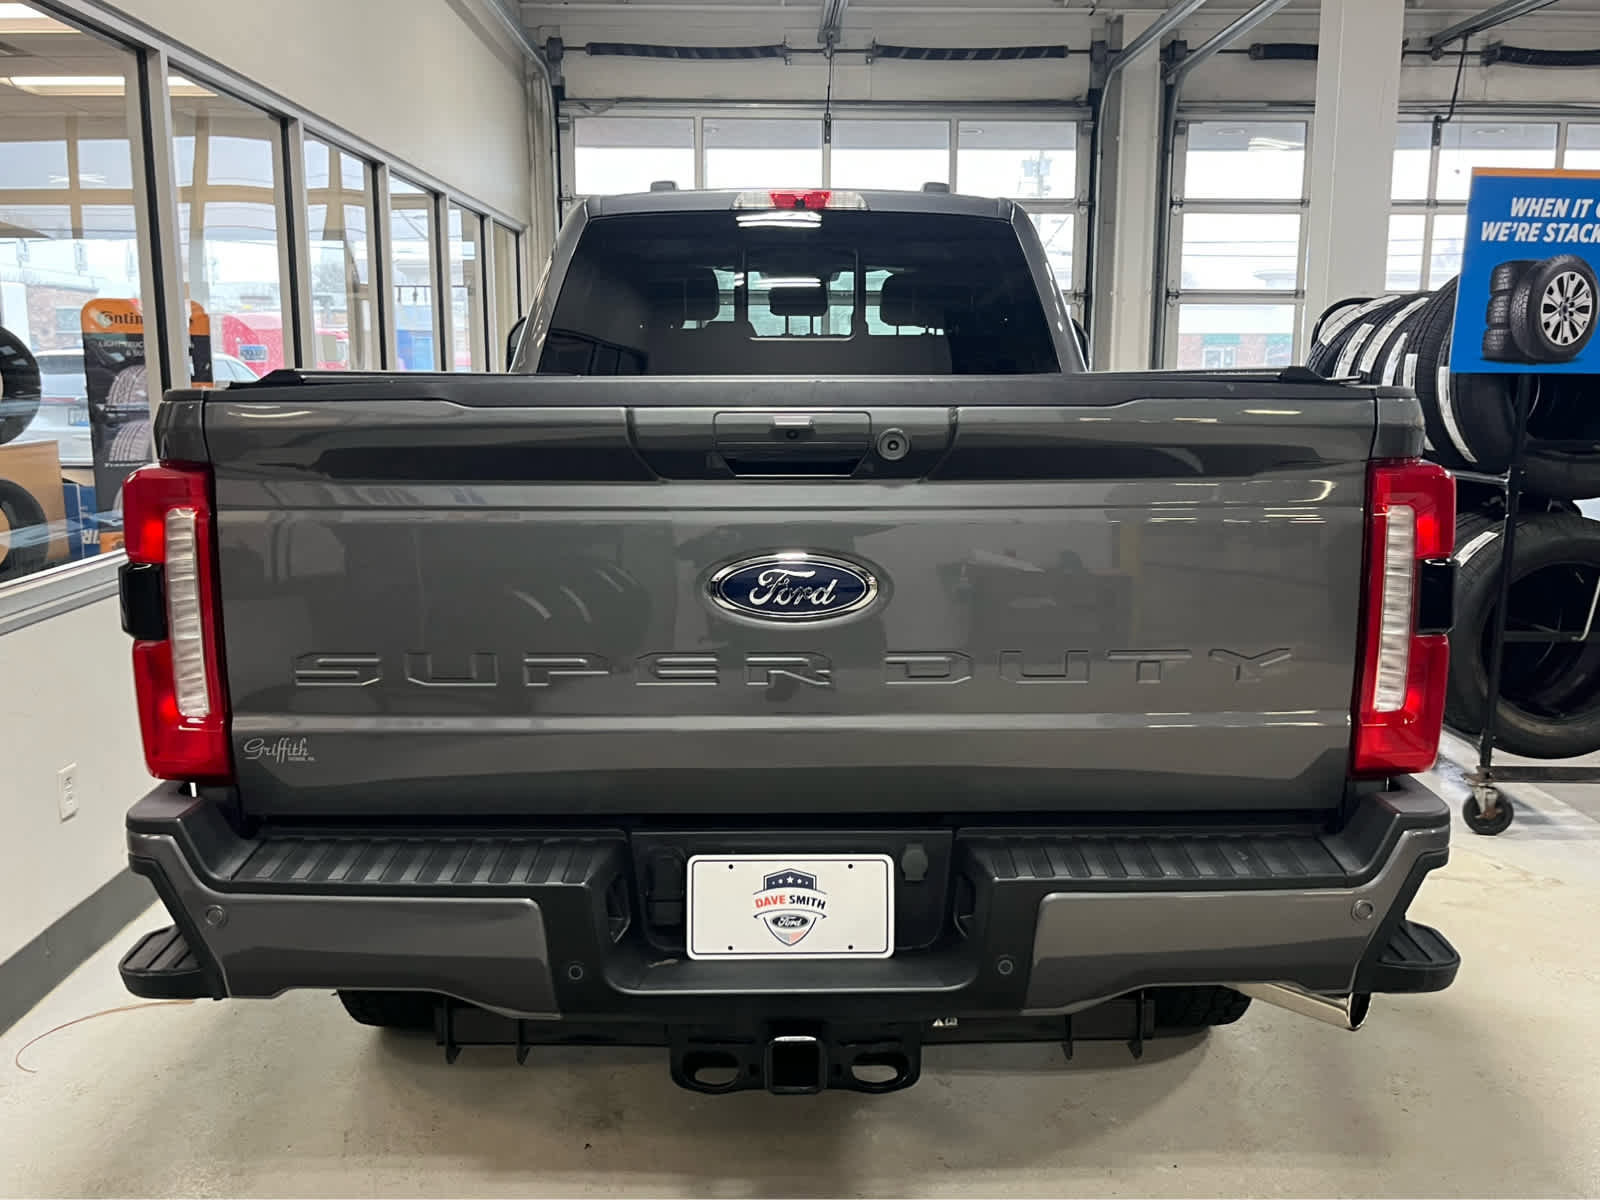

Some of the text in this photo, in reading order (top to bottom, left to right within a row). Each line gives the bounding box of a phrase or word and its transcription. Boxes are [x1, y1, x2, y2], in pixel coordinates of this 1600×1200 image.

[1510, 197, 1570, 218] WHEN
[1571, 198, 1594, 218] IT
[1481, 221, 1542, 242] WE'RE
[749, 568, 839, 605] Ford
[295, 649, 1293, 687] SUPER DUTY
[243, 737, 309, 764] Griffith
[755, 895, 826, 910] DAVE SMITH
